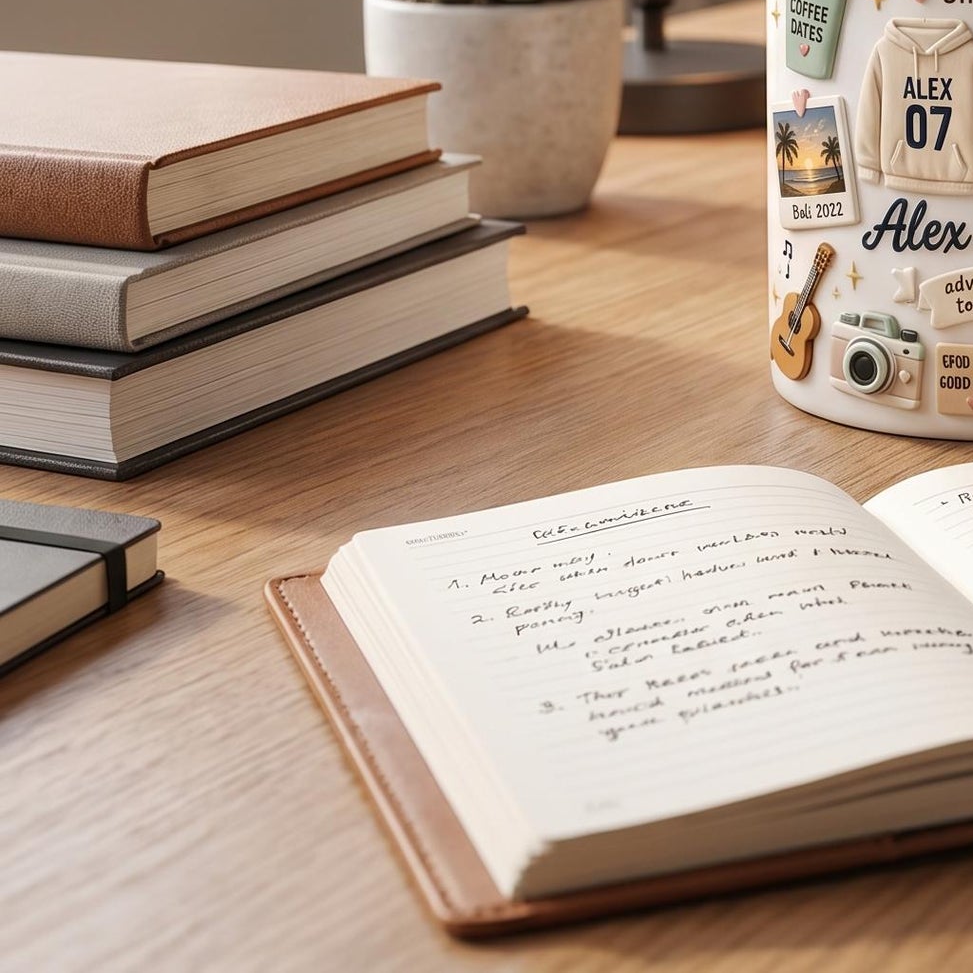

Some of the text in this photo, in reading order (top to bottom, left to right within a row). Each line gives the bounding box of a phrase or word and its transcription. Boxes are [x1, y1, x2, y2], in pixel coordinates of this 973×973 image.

[791, 18, 823, 43] DATES
[903, 76, 952, 101] ALEX
[905, 104, 953, 151] 07
[816, 201, 843, 218] 2022
[862, 198, 972, 253] Alex
